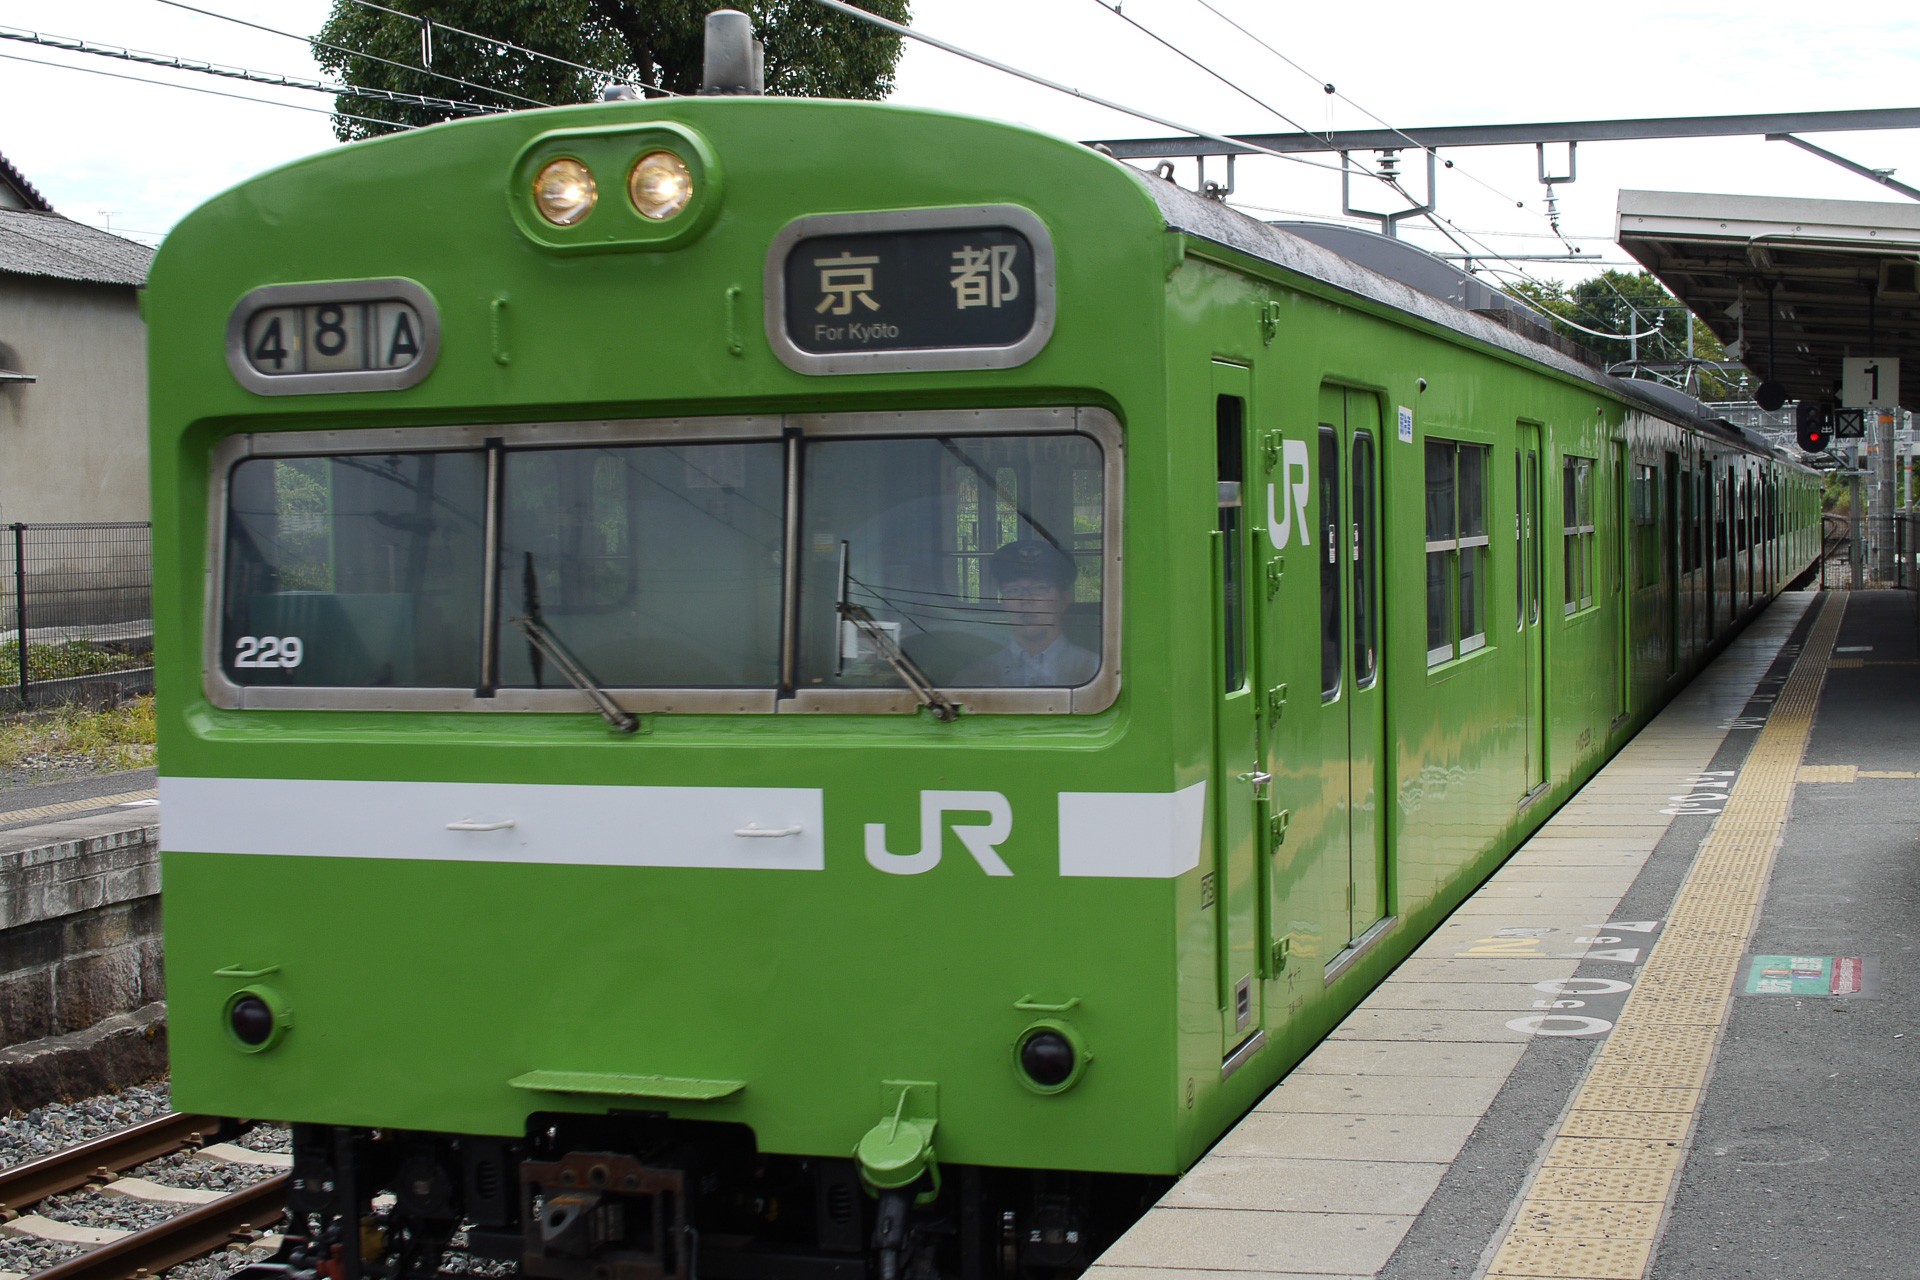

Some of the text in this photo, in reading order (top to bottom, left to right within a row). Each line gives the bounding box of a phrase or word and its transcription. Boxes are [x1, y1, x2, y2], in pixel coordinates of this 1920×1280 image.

[814, 245, 1019, 315] 京都
[815, 324, 845, 341] For
[1864, 365, 1879, 400] 1
[1267, 439, 1310, 550] JR
[234, 635, 304, 668] 229
[864, 790, 1015, 877] JR
